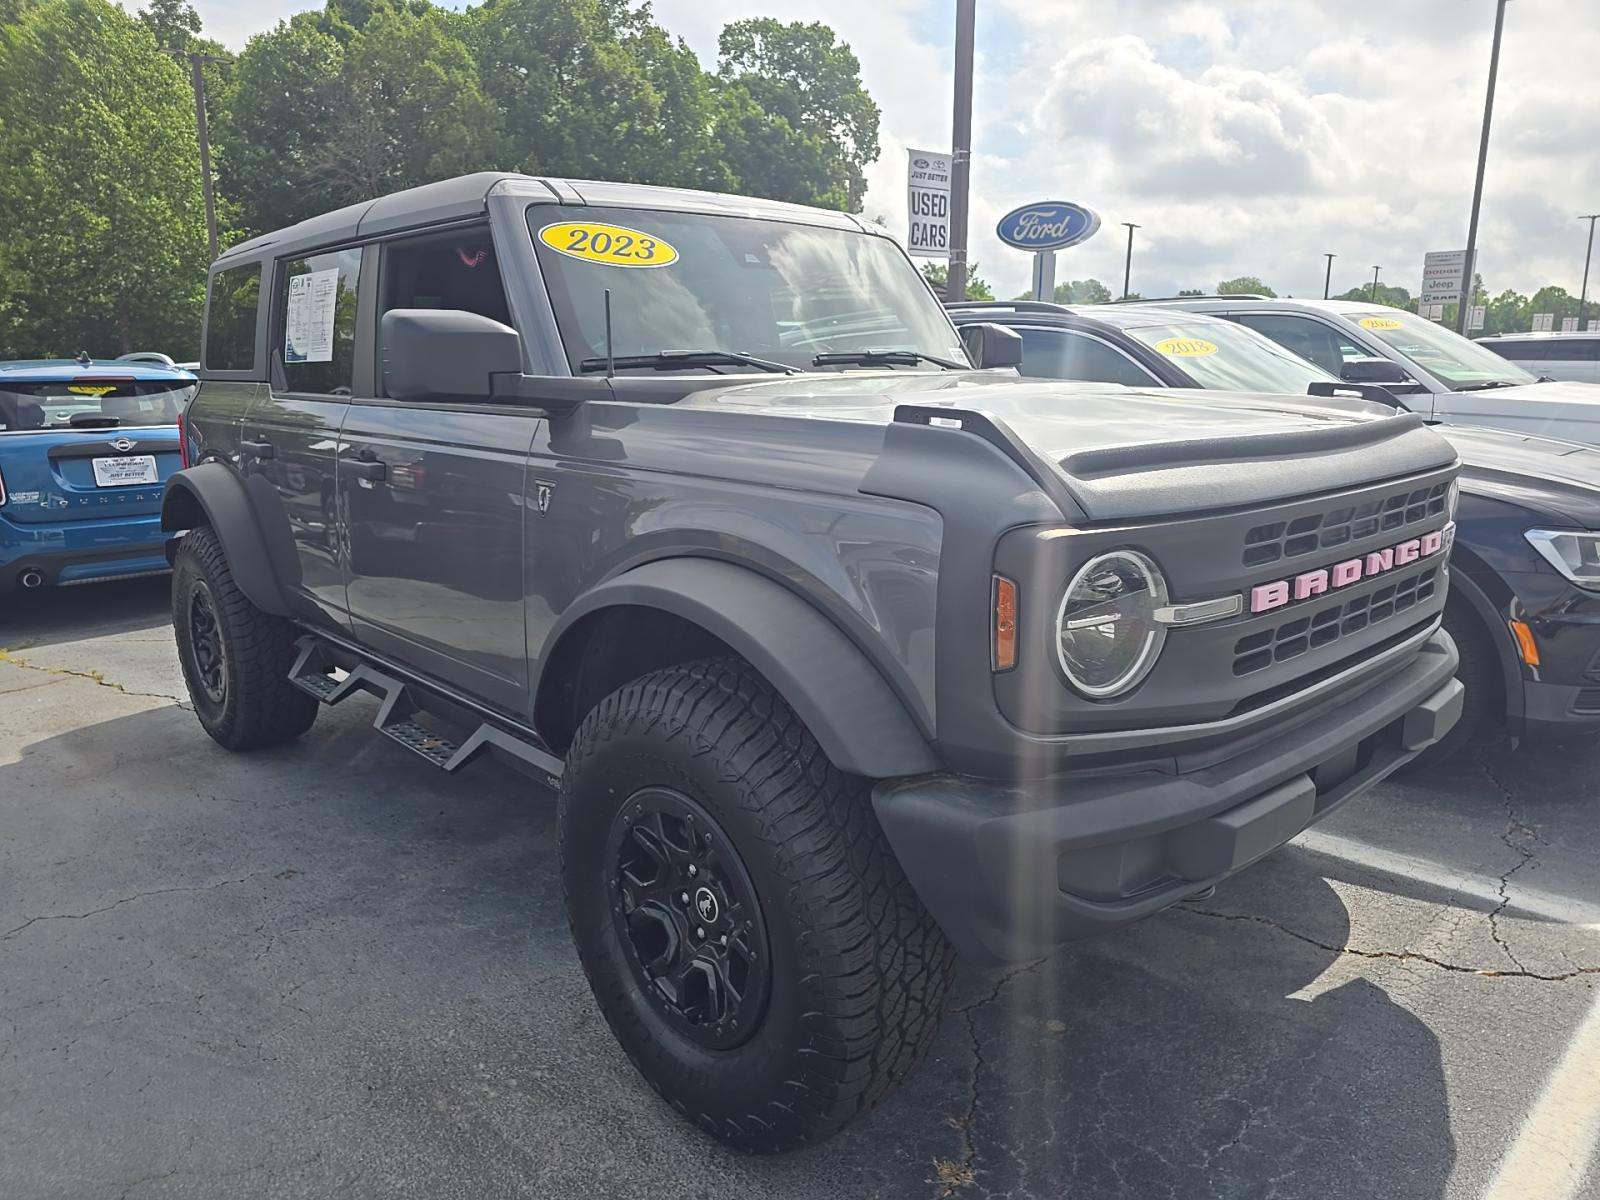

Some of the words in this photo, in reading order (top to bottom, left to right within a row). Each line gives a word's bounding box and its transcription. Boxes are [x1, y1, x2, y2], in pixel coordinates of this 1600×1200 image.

[911, 171, 927, 179] JUST
[927, 173, 948, 182] BETTER
[911, 191, 947, 218] USED
[910, 222, 946, 248] CARS
[1013, 210, 1070, 240] Ford
[566, 229, 656, 260] 2023
[1429, 280, 1454, 289] Jeep
[1251, 530, 1442, 613] BRONCO
